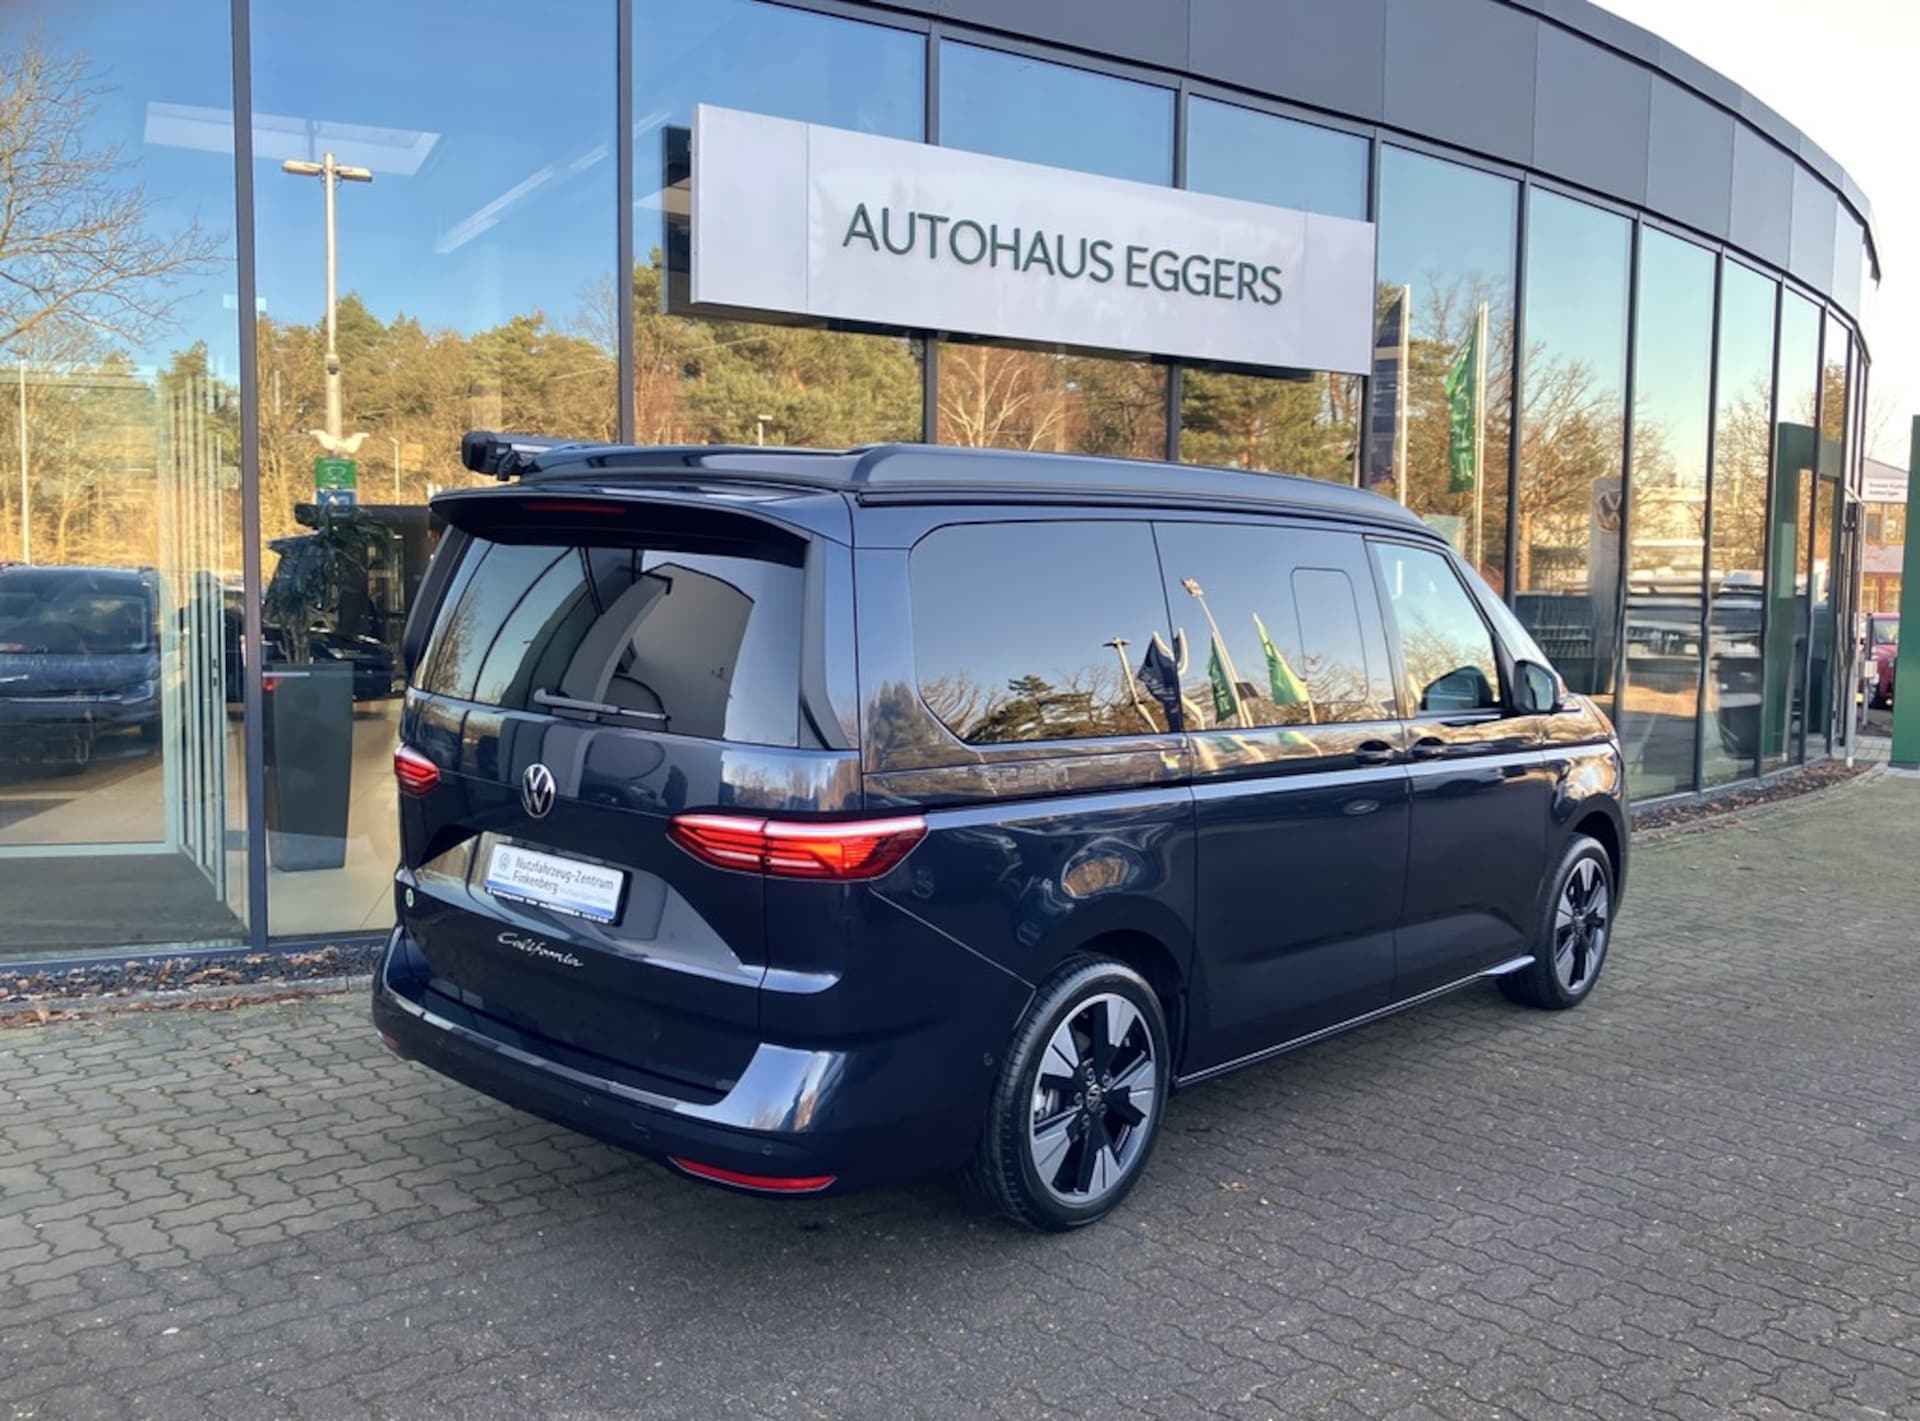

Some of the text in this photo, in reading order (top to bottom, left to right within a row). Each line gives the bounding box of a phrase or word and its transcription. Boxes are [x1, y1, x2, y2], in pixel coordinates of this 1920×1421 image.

[842, 202, 1283, 306] AUTOHAUS EGGERS
[511, 869, 560, 896] Finkenberg
[514, 855, 615, 890] Nutzfahrzeug-Zentrum
[497, 931, 584, 968] California
